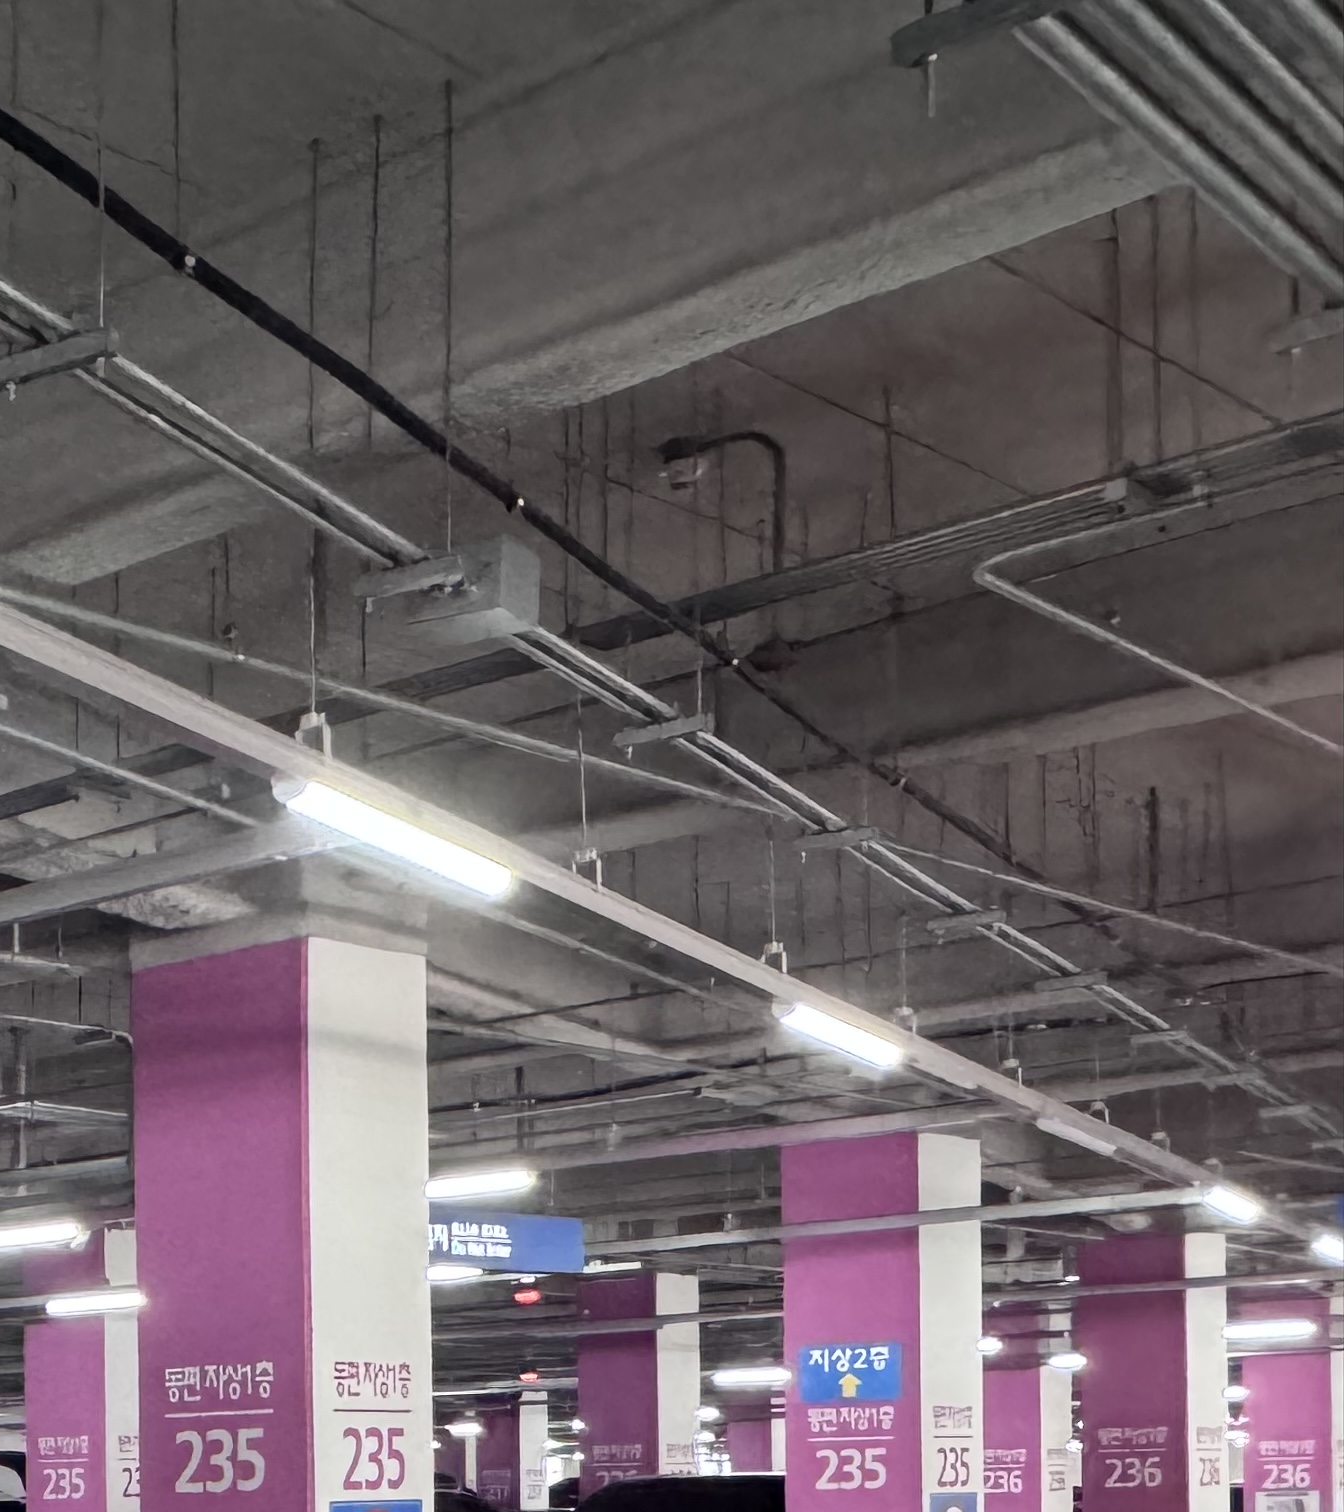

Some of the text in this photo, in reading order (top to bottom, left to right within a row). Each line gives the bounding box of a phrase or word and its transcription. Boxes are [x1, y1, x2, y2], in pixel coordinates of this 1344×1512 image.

[809, 1347, 890, 1373] 지상2층
[175, 1427, 266, 1494] 235
[342, 1426, 406, 1491] 235
[815, 1447, 887, 1490] 235
[937, 1447, 970, 1487] 235
[1104, 1457, 1162, 1488] 236
[43, 1467, 85, 1500] 235
[984, 1470, 1023, 1493] 236
[1262, 1463, 1311, 1490] 236
